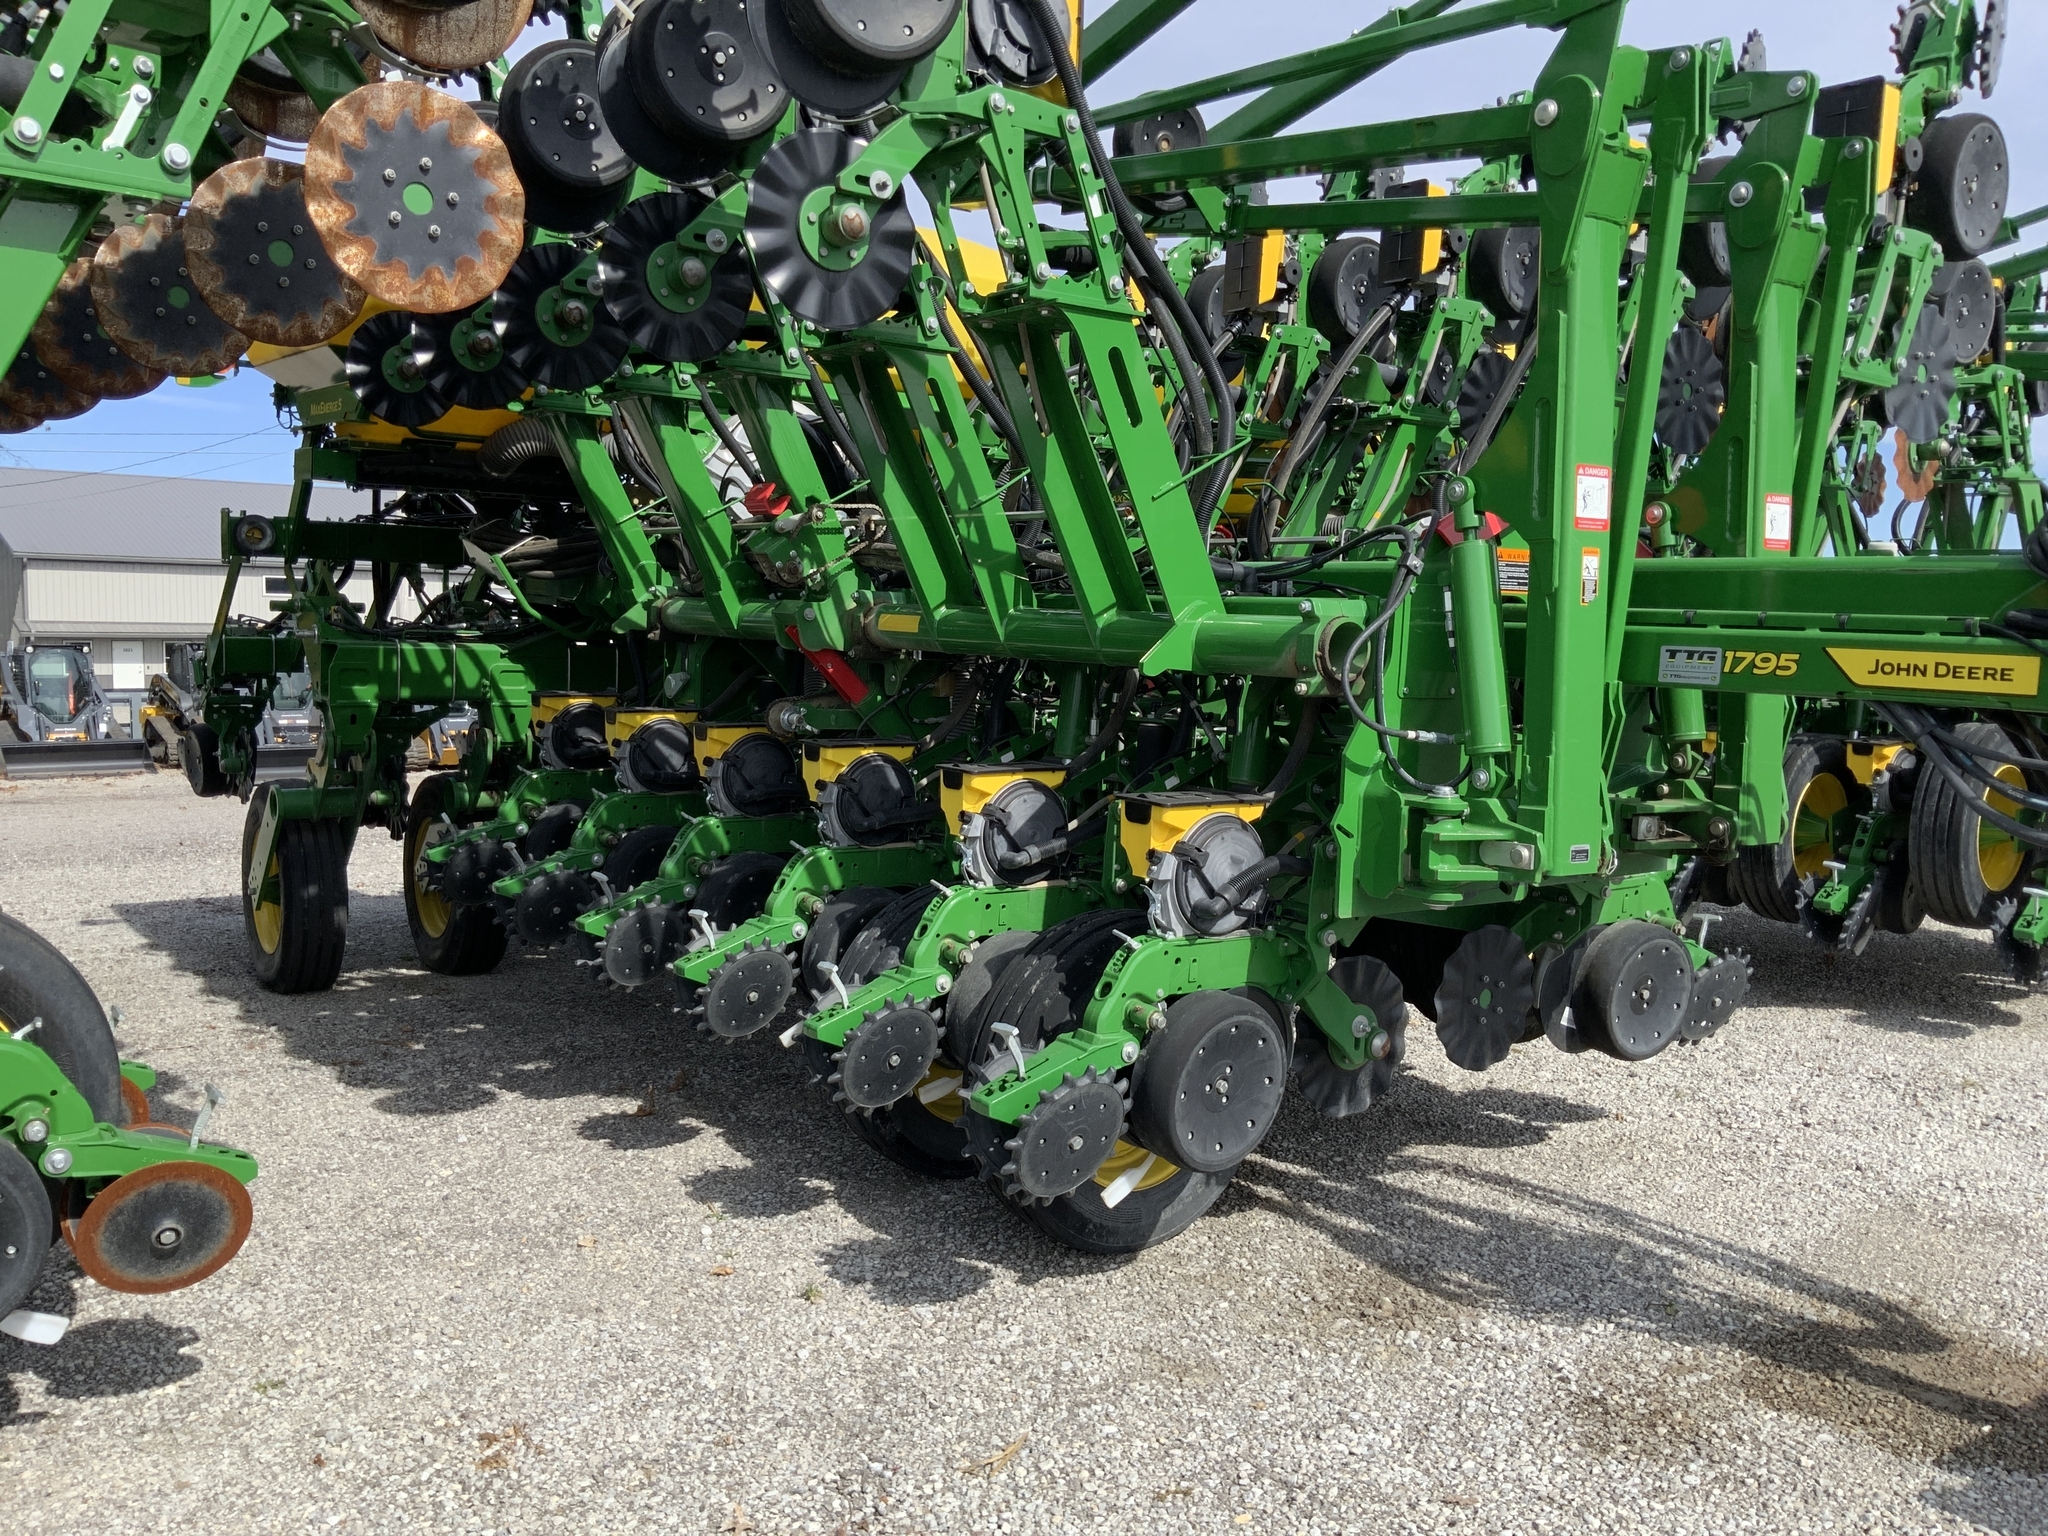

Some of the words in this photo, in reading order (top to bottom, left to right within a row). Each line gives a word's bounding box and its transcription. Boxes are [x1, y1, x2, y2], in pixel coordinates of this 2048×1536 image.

[1585, 466, 1609, 477] DANGER
[1772, 495, 1790, 504] DANGER
[1665, 649, 1718, 664] TTG
[1722, 650, 1801, 676] 1795
[1867, 658, 1928, 678] JOHN
[1934, 661, 2015, 682] DEERE
